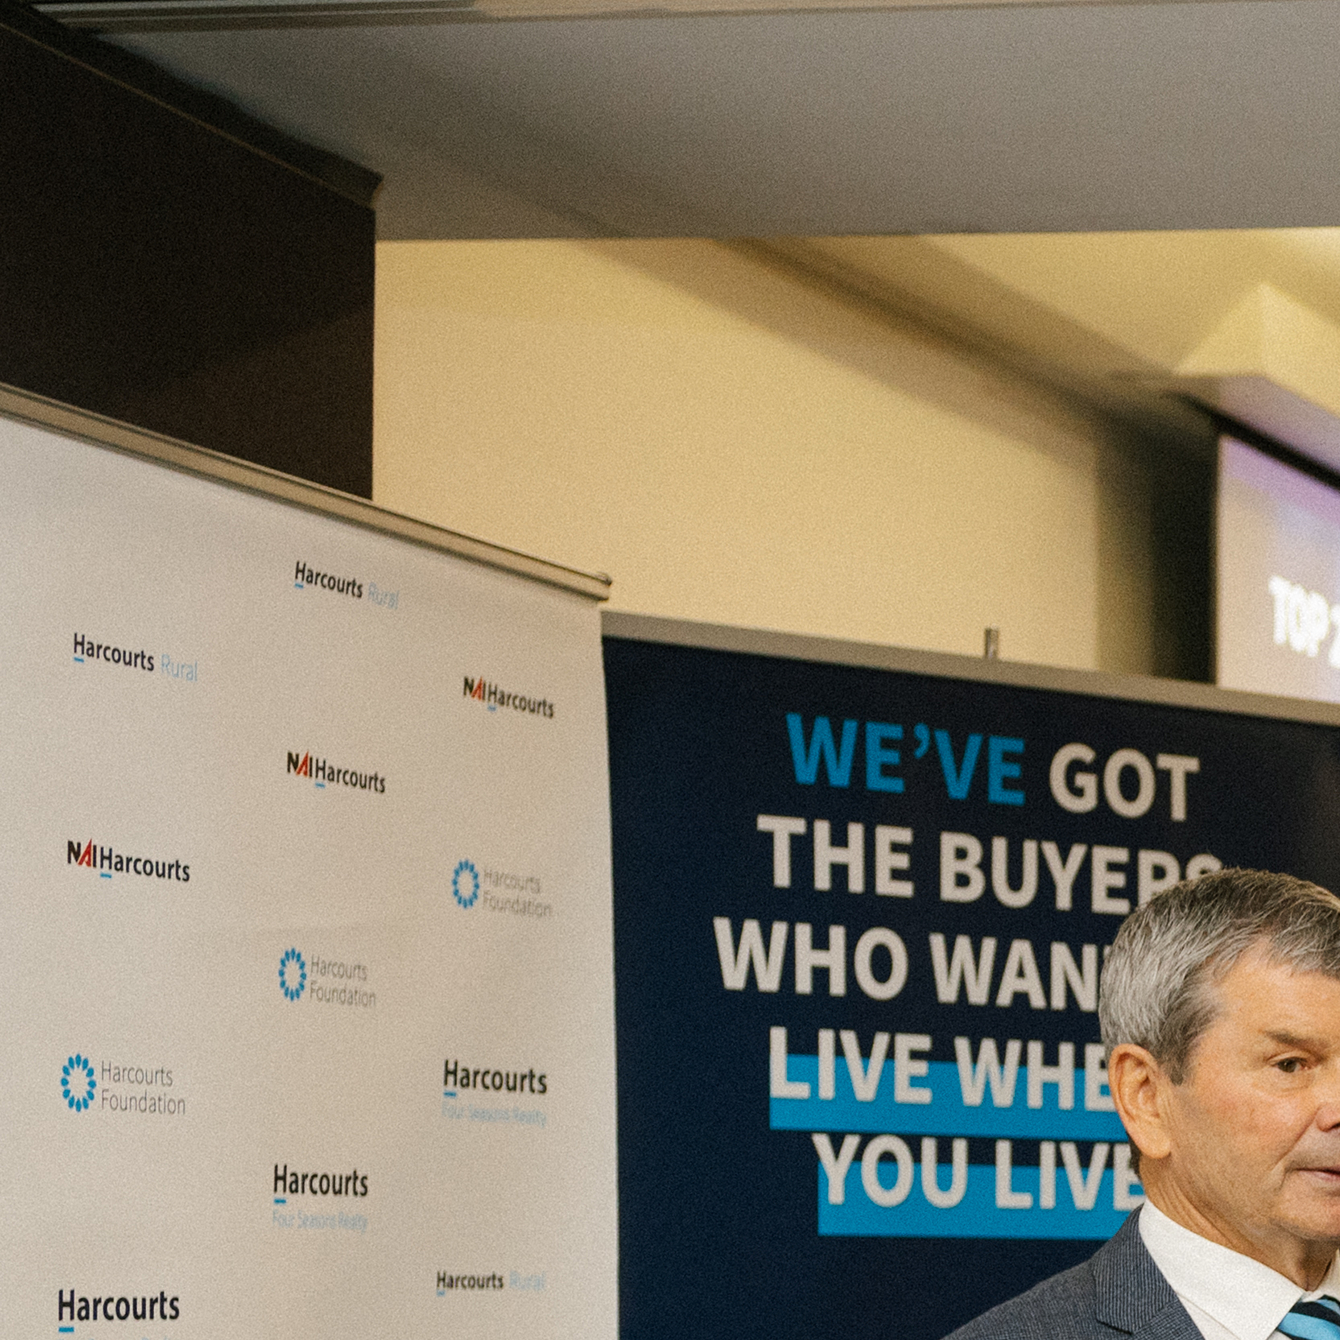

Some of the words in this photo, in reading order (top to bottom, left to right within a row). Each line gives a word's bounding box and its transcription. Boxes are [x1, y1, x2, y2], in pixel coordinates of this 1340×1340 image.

[294, 561, 363, 599] Harcourts
[73, 632, 155, 672] Harcourts
[487, 684, 555, 719] Harcourts
[315, 758, 386, 794] Harcourts
[786, 712, 1025, 806] WE'VE
[1049, 743, 1199, 821] GOT
[99, 846, 190, 883] Harcourts
[756, 814, 914, 898] THE
[713, 917, 908, 1000] WHO
[929, 932, 1106, 1013] WAN
[443, 1060, 548, 1094] Harcourts
[769, 1027, 932, 1103] LIVE
[954, 1036, 1118, 1112] WHE
[273, 1164, 369, 1197] Harcourts
[811, 1134, 966, 1208] YOU
[995, 1139, 1147, 1212] LIVE
[436, 1271, 504, 1291] Harcourts
[58, 1290, 180, 1321] Harcourts
